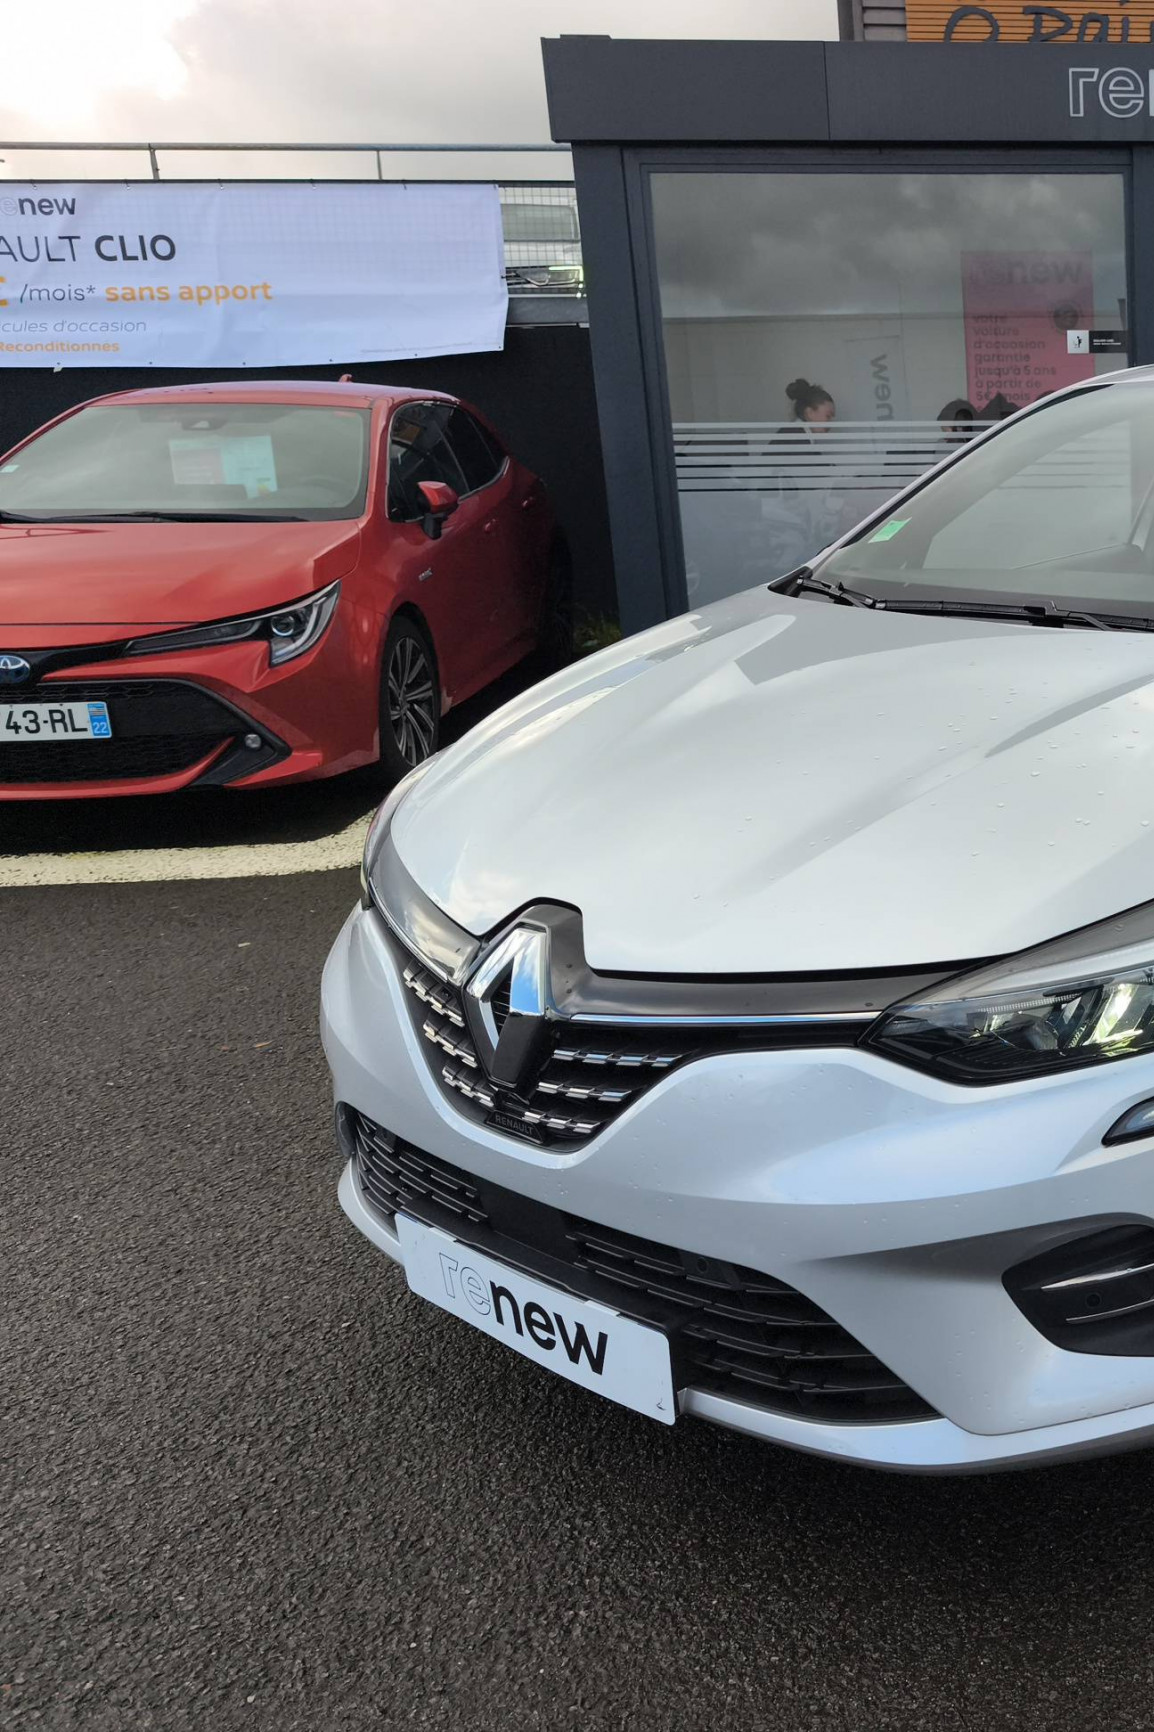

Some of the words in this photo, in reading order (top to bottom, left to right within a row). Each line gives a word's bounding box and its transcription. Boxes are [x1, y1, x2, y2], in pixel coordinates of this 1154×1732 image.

[94, 234, 176, 262] CLIO
[104, 285, 171, 302] sans
[178, 282, 273, 306] apport
[0, 320, 49, 333] cules
[52, 319, 147, 333] d'occasion
[974, 352, 1031, 365] garantie
[1033, 366, 1057, 376] ans
[5, 708, 88, 735] 43-RL
[92, 721, 108, 734] 22
[494, 1113, 534, 1136] RENAULT
[438, 1252, 608, 1376] renew
